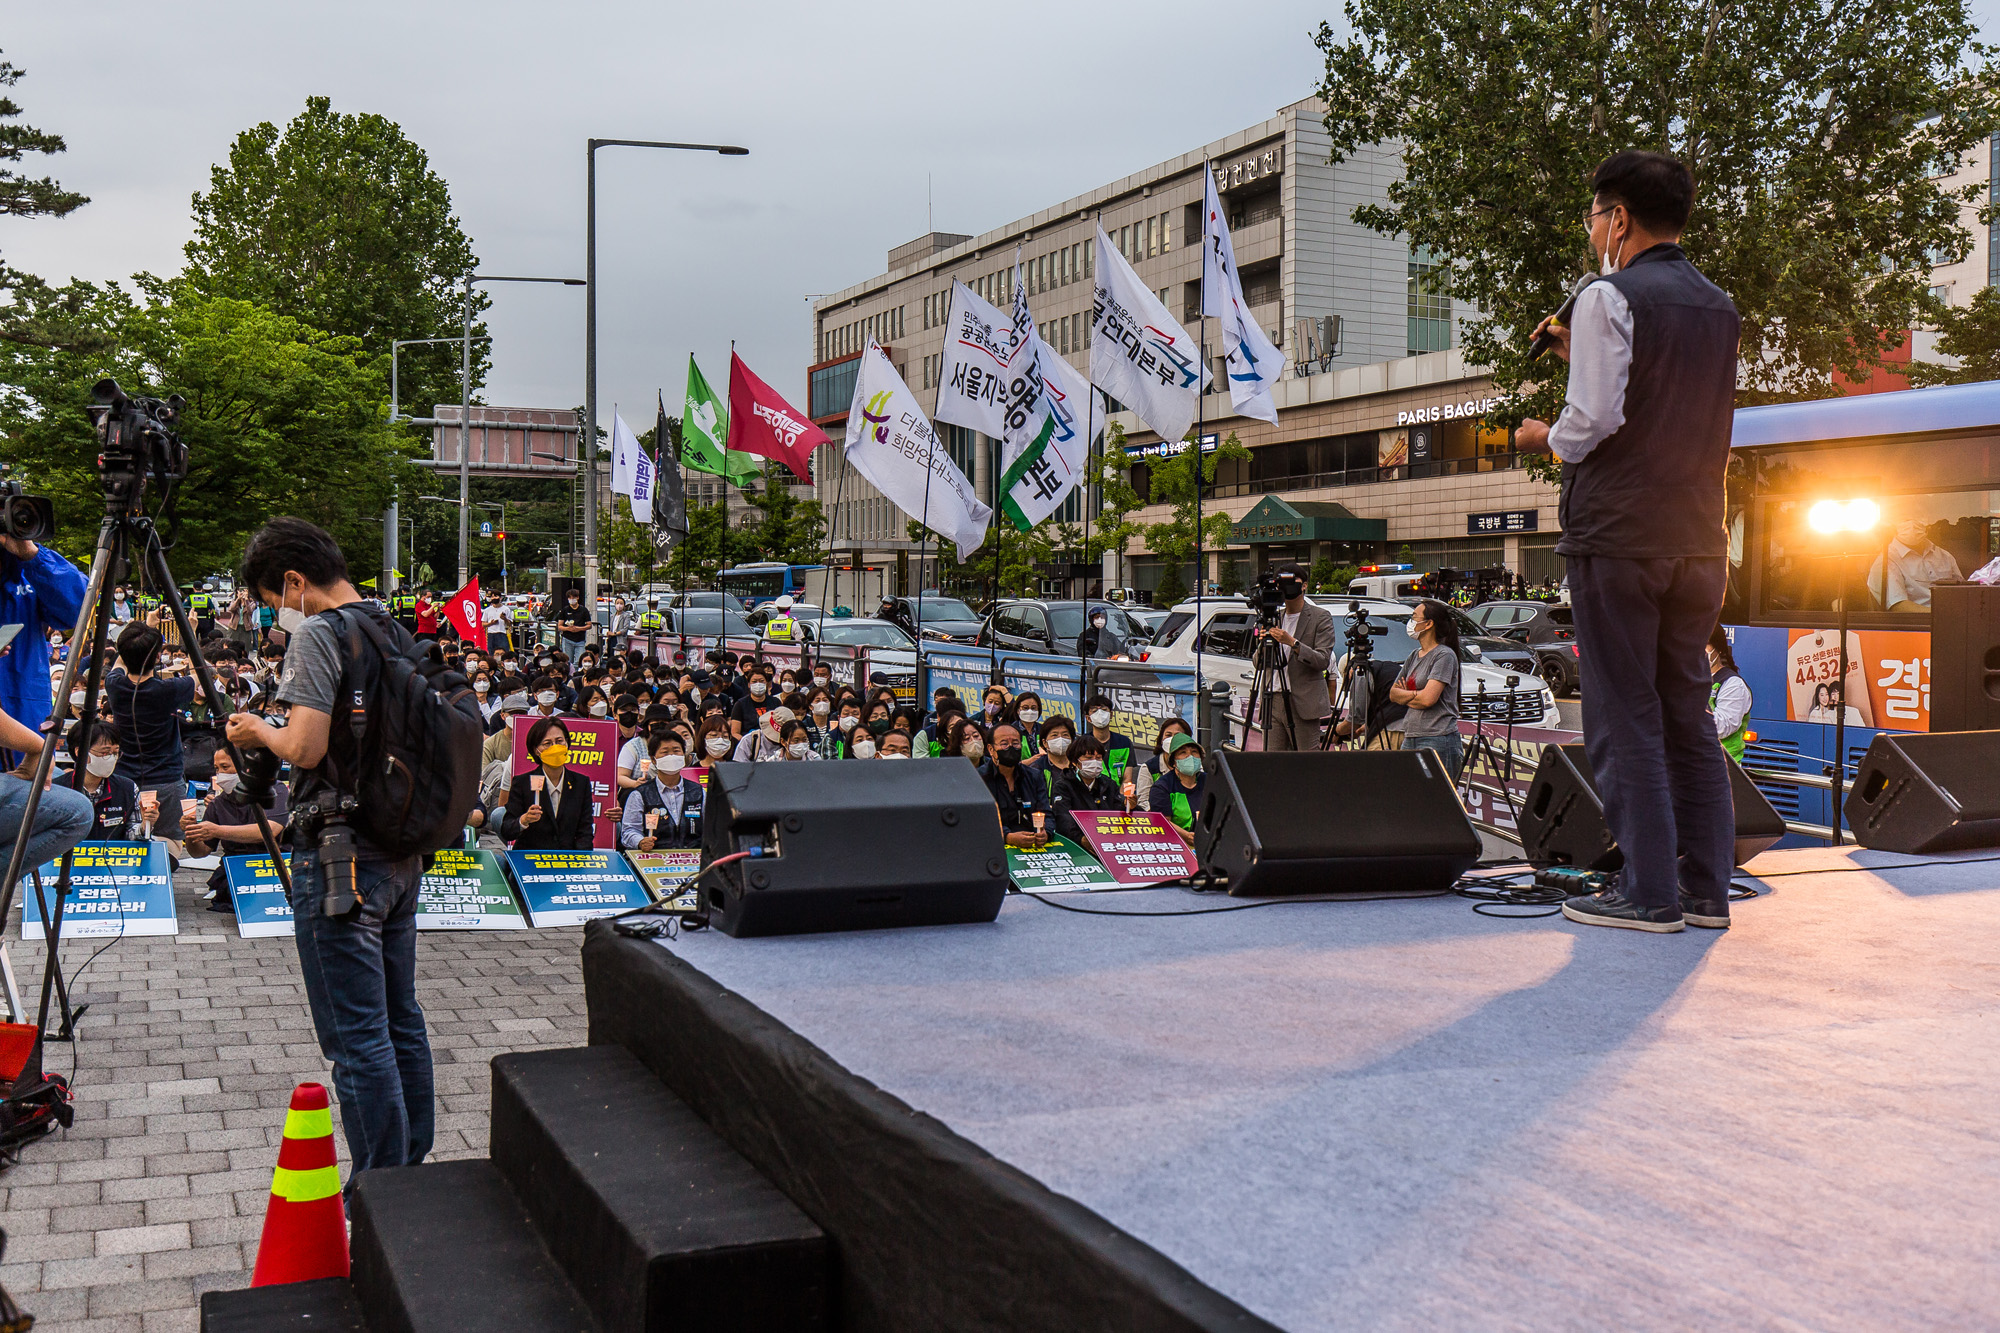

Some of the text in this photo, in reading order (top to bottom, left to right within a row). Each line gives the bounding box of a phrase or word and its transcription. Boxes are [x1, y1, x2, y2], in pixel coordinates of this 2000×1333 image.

[1218, 149, 1274, 191] 방컨벤션
[961, 323, 1009, 362] 공공운수노
[1397, 406, 1441, 426] PARIS
[1477, 516, 1501, 530] 국방부
[1812, 646, 1841, 662] 성혼회원
[1877, 657, 1931, 720] 결
[1493, 702, 1509, 711] Ford
[569, 731, 597, 747] 안전
[1096, 816, 1152, 825] 국민안전
[1127, 826, 1165, 835] STOP!
[61, 846, 148, 857] 민안전에
[78, 888, 122, 899] 전면
[566, 884, 602, 893] 전면
